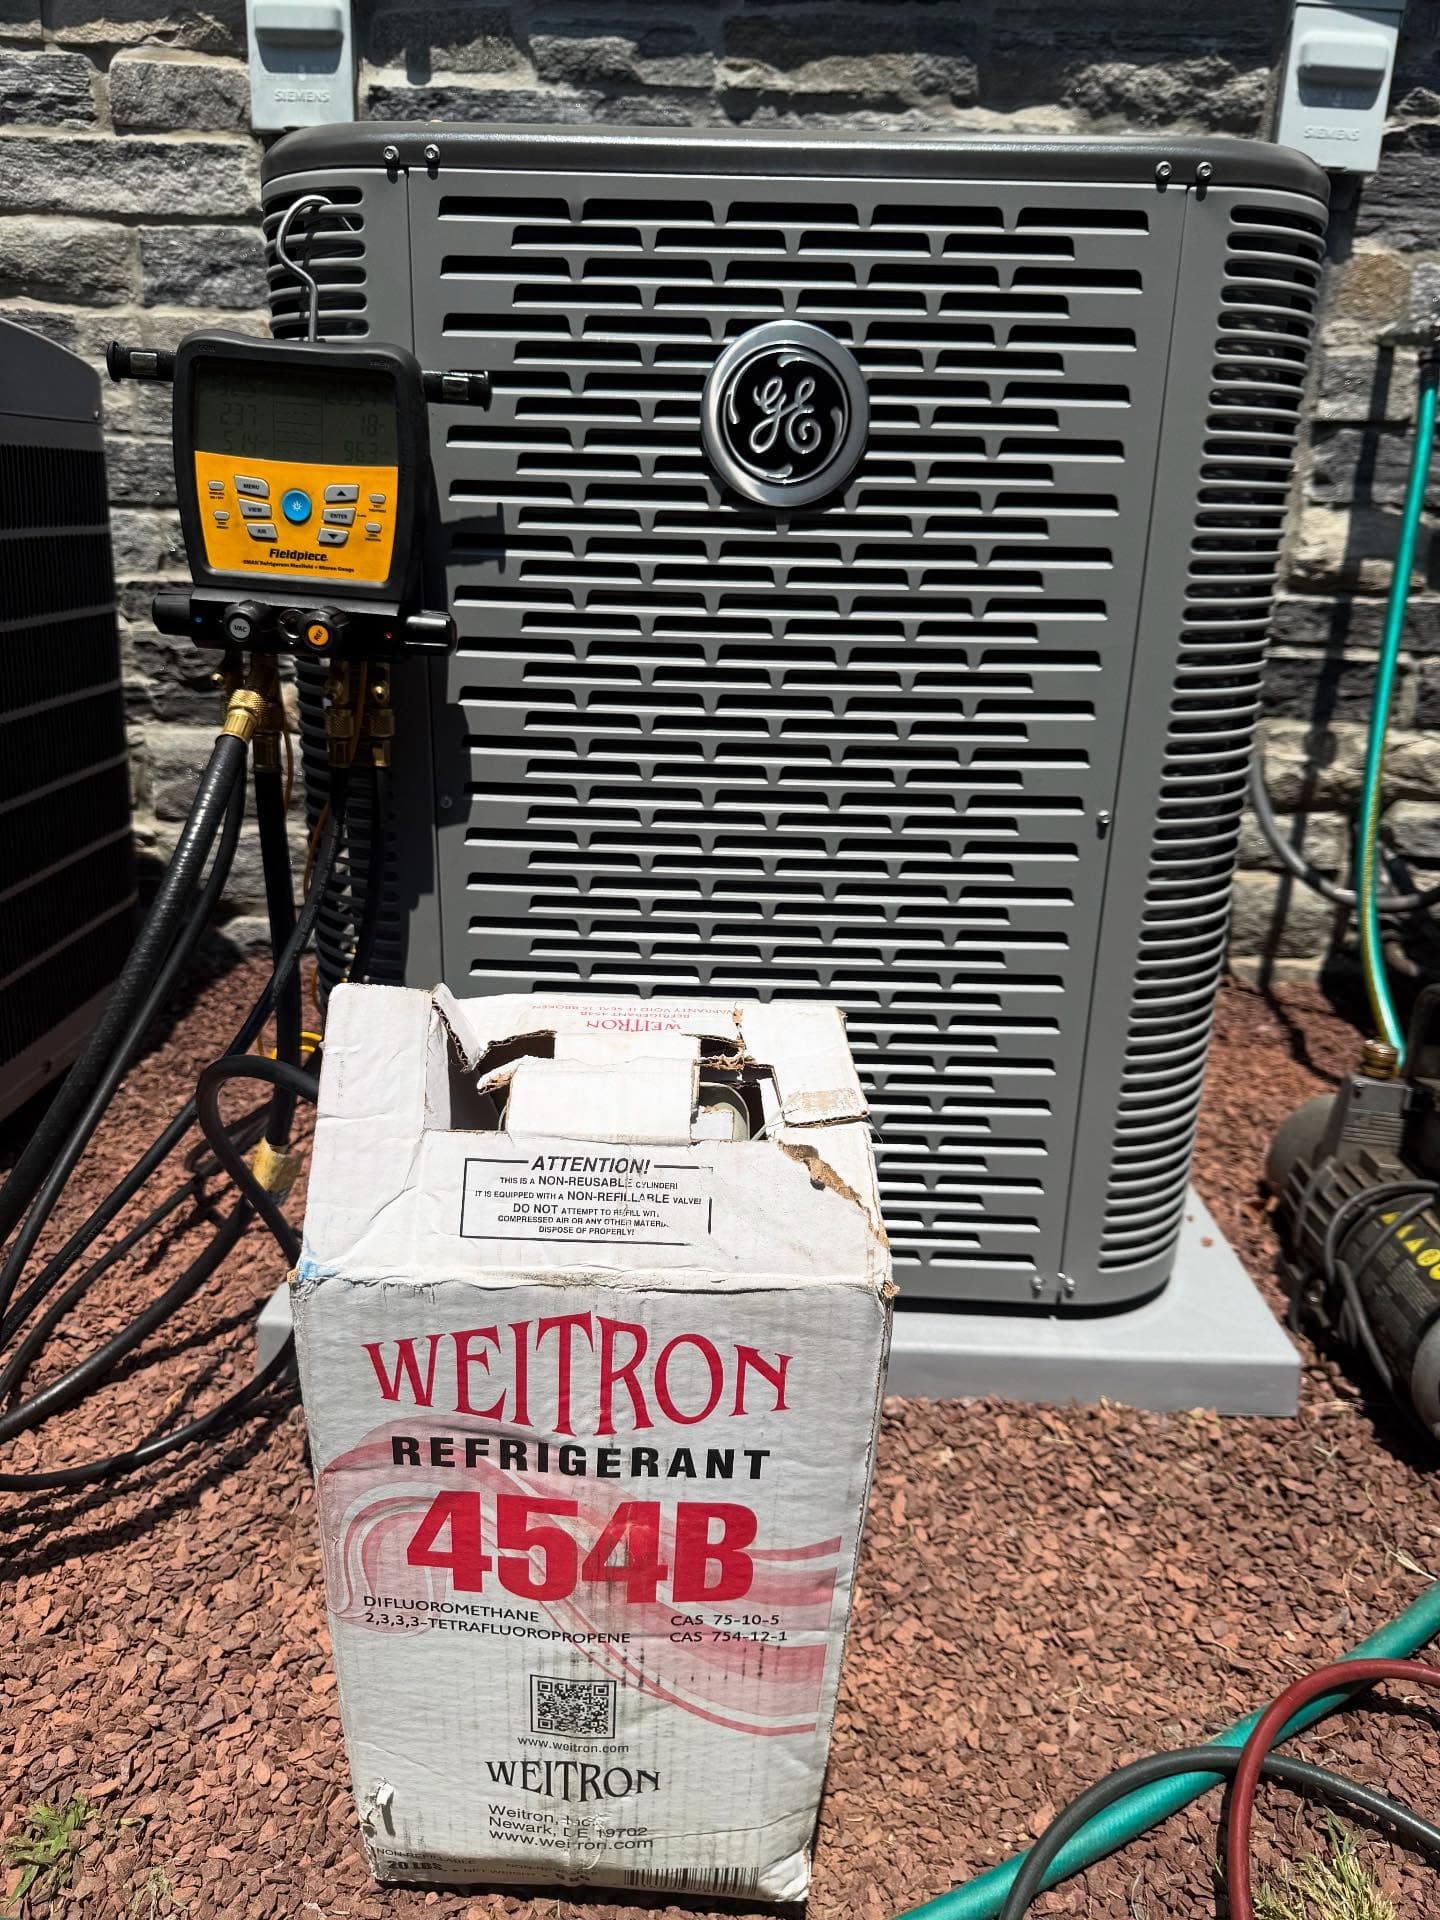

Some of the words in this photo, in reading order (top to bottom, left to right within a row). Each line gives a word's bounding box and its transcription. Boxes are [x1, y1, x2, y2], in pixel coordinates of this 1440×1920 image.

[274, 89, 331, 103] SIEMENS
[1303, 125, 1361, 142] SIEMENS
[269, 548, 328, 561] Fieldpiece
[233, 624, 248, 633] VAC
[610, 1011, 690, 1019] REFRIGERANT
[585, 1018, 682, 1033] WEITRON
[531, 1155, 651, 1175] ATTENTION!
[500, 1176, 518, 1184] THIS
[538, 1175, 633, 1188] NON-REUSABLE
[484, 1190, 492, 1198] IS
[494, 1191, 535, 1199] EQUIPPED
[536, 1192, 556, 1200] WITH
[567, 1190, 670, 1204] NON-REFILLABLE
[672, 1197, 702, 1205] VALVE!
[513, 1203, 530, 1213] DO
[533, 1204, 558, 1214] NOT
[561, 1208, 599, 1216] ATTEMPT
[601, 1208, 611, 1216] TO
[642, 1210, 660, 1218] WIT
[497, 1215, 554, 1223] COMPRESSED
[572, 1217, 583, 1225] OR
[604, 1218, 632, 1226] OTHER
[538, 1226, 574, 1234] DISPOSE
[576, 1227, 587, 1235] OF
[588, 1228, 635, 1236] PROPERLY!
[361, 1311, 794, 1436] WEITRON
[391, 1436, 771, 1480] REFRIGERANT
[406, 1490, 758, 1604] 454B
[363, 1595, 540, 1623] DIFLUOROMETHANE
[670, 1614, 704, 1626] CAS
[713, 1614, 780, 1626] 75-10-5
[365, 1612, 631, 1644] 2,3,3,3-TETRAFLUOROPROPENE
[669, 1631, 703, 1643] CAS
[712, 1631, 788, 1643] 754-12-1
[517, 1736, 629, 1754] www.weitron.com
[484, 1760, 661, 1803] WEITRON
[488, 1803, 558, 1826] Weitron,
[489, 1816, 556, 1837] Newark,
[563, 1827, 589, 1838] DE
[597, 1827, 648, 1839] 19702
[489, 1830, 653, 1850] www.weiron.com
[387, 1860, 409, 1870] 20
